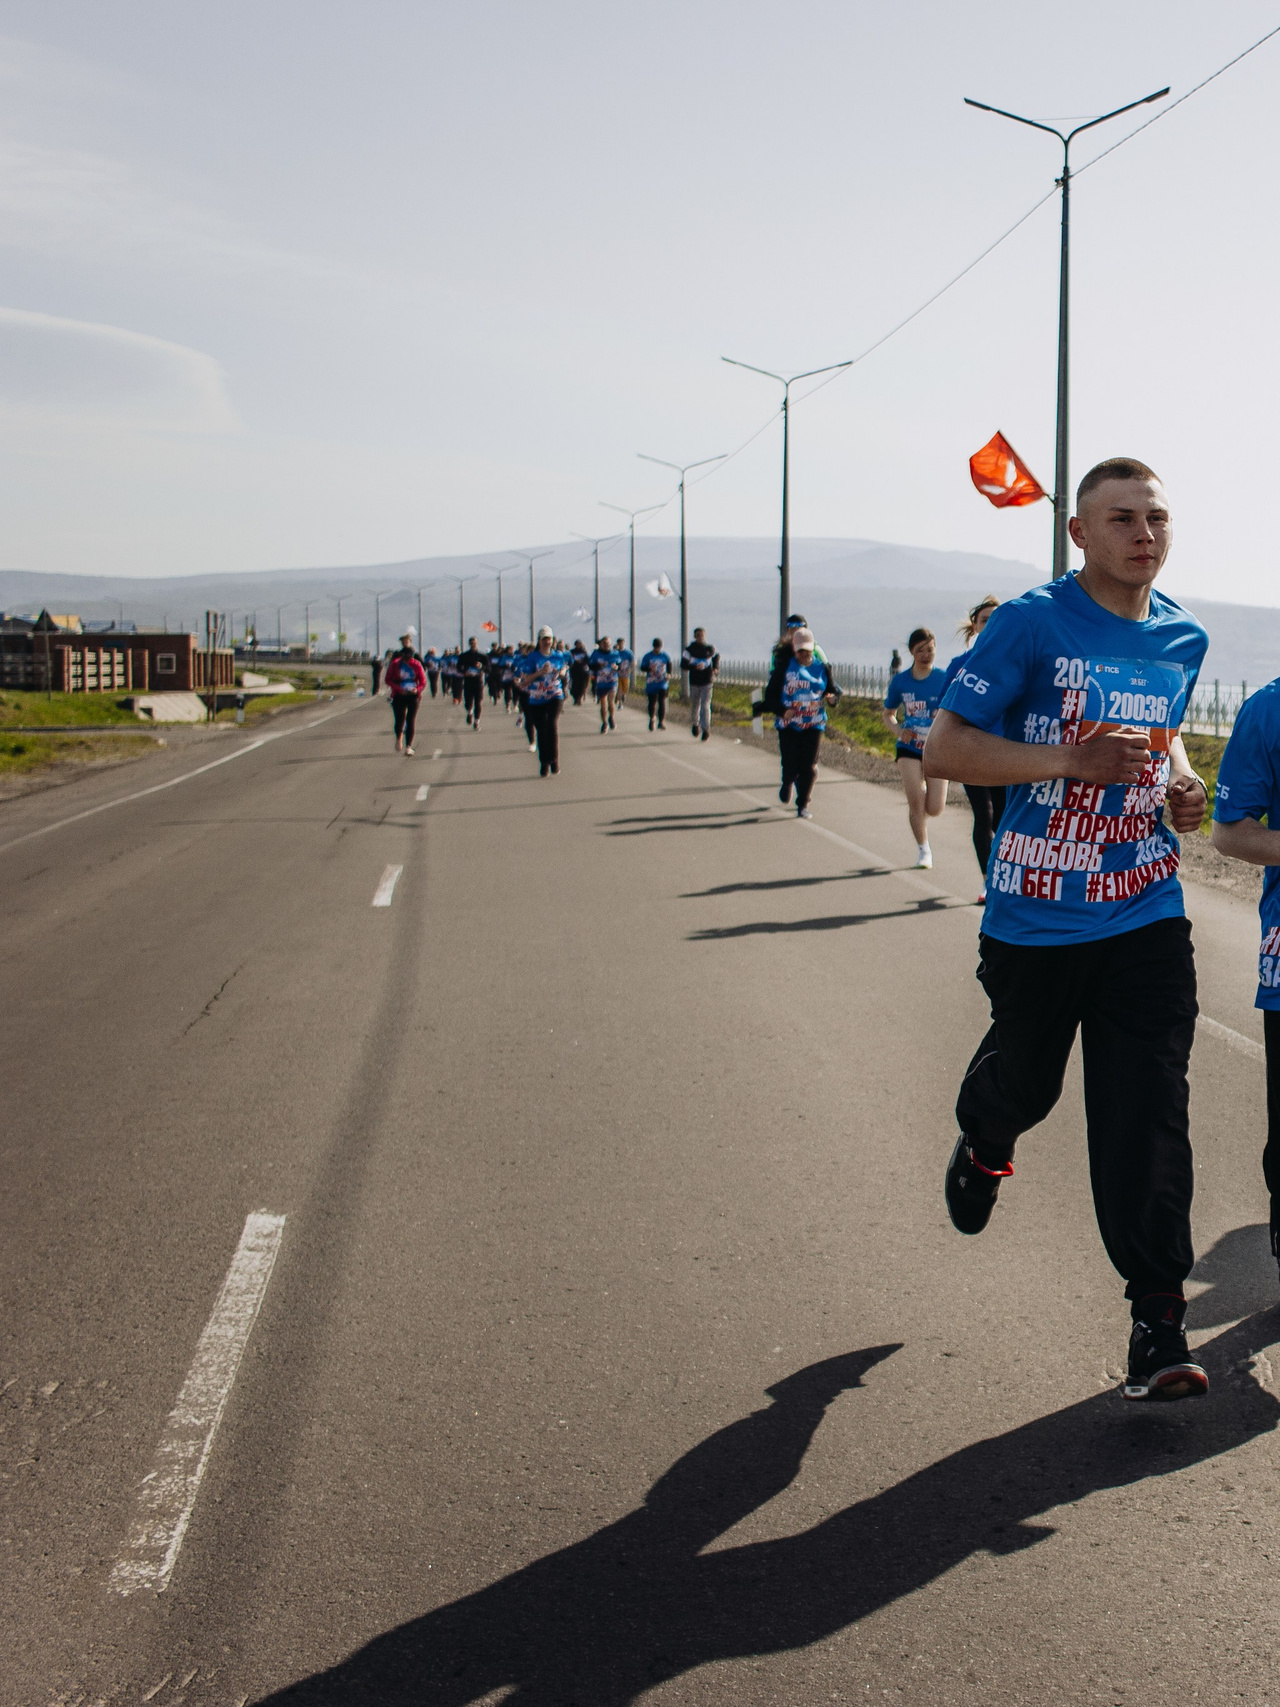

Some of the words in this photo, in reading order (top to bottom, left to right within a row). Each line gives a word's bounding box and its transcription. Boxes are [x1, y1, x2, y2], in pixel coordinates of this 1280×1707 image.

[1104, 665, 1120, 674] ПСБ
[1108, 691, 1169, 723] 20036
[997, 830, 1106, 872] #ЛЮБОВЬ
[992, 860, 1064, 900] #ЗАБЕГ
